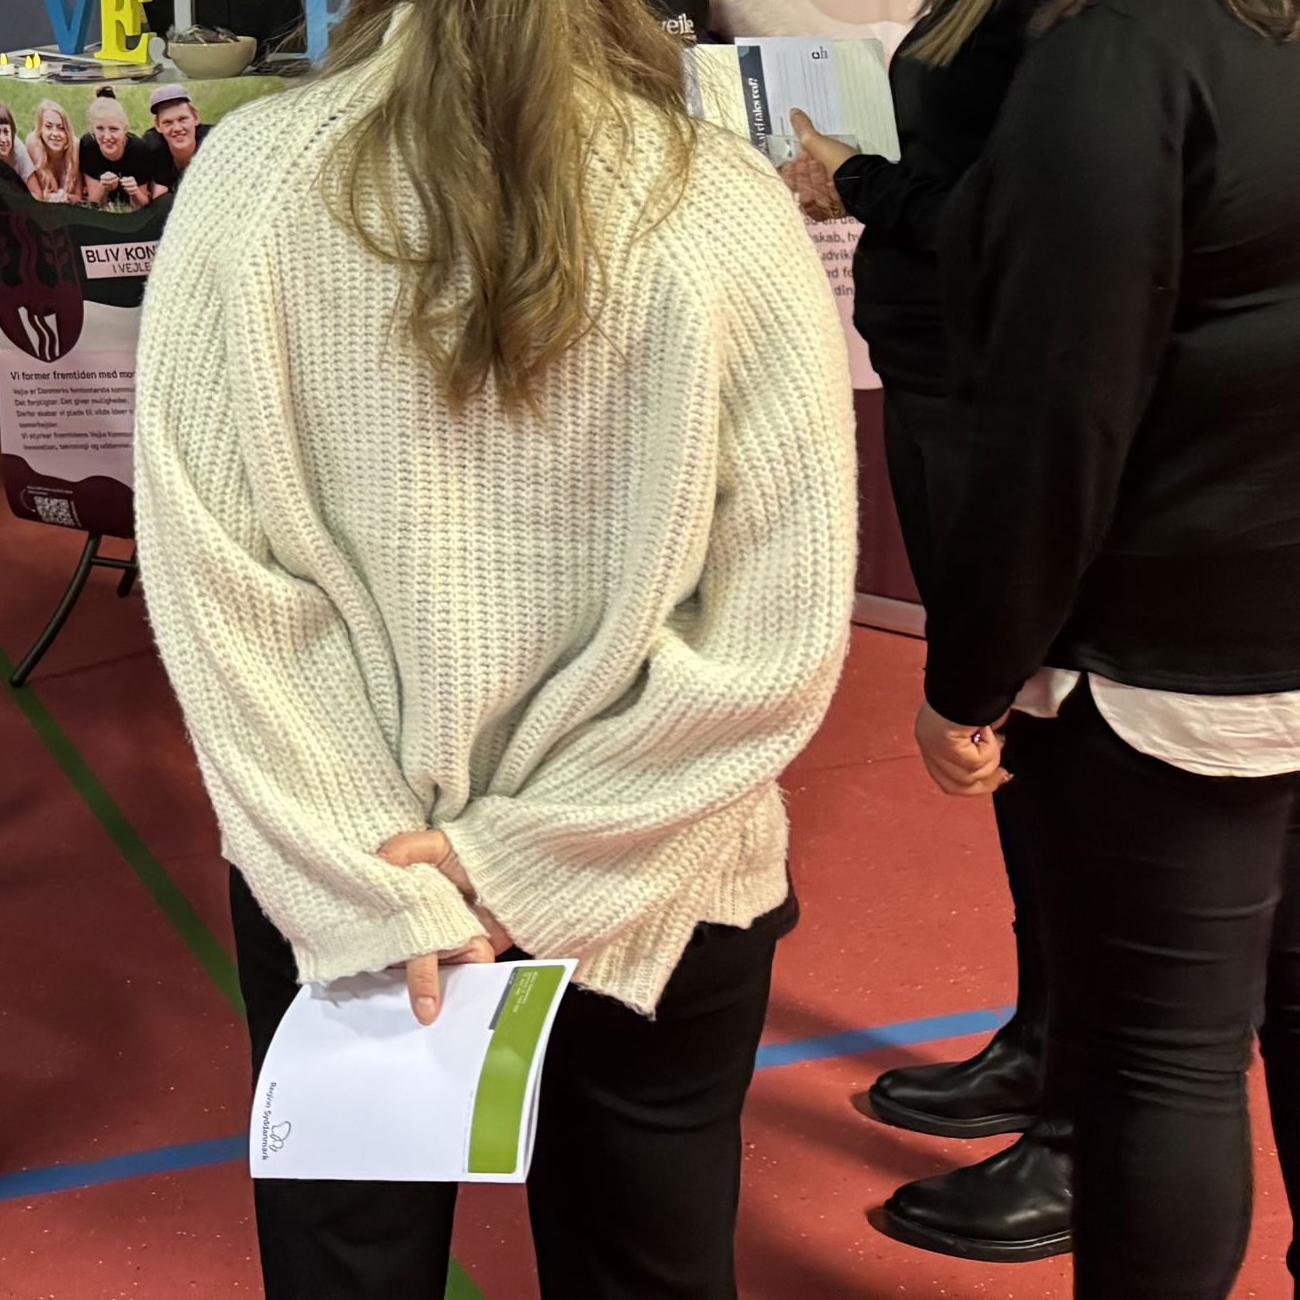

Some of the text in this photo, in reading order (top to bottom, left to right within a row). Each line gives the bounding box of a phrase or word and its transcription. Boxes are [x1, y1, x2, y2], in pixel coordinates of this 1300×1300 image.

[85, 247, 120, 264] BLIV
[117, 261, 151, 274] VEJLE
[10, 371, 20, 380] Vi
[21, 371, 51, 381] former
[53, 370, 97, 380] fremtiden
[98, 370, 117, 379] med
[260, 1081, 277, 1162] Region Syddanmark
